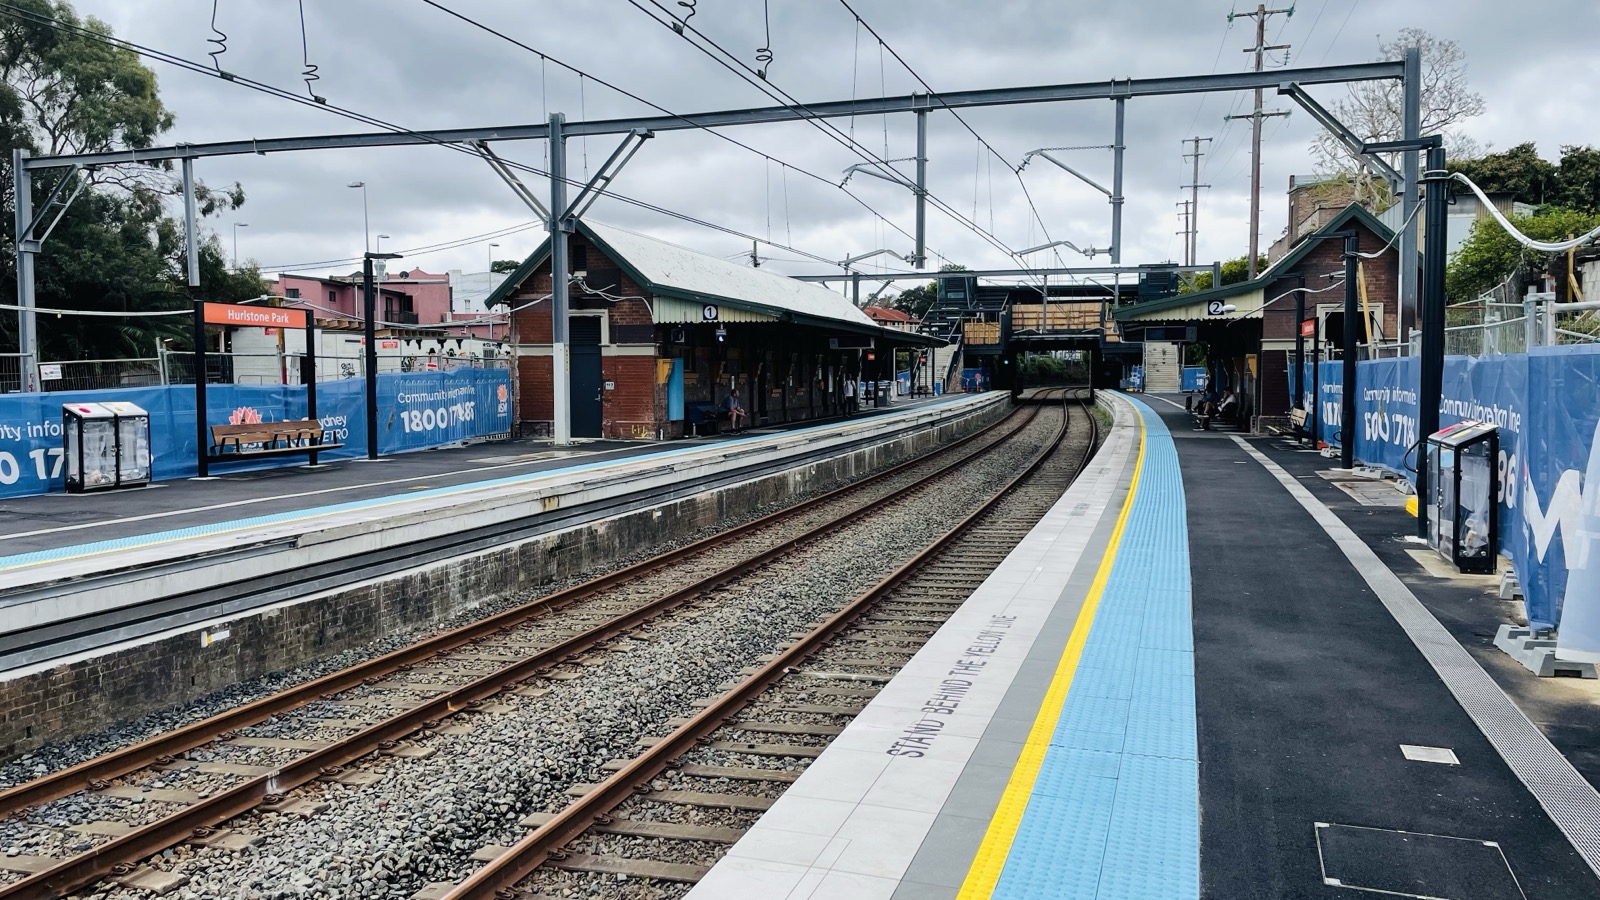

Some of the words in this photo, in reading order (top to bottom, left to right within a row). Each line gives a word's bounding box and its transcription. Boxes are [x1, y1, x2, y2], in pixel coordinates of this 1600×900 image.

[228, 309, 270, 322] Hurlstone
[271, 312, 290, 324] Park
[317, 414, 347, 431] ydney
[400, 407, 448, 433] 1800
[318, 428, 349, 443] ETRO
[886, 719, 945, 758] STAND
[921, 679, 973, 715] BEHIND
[948, 659, 987, 676] THE
